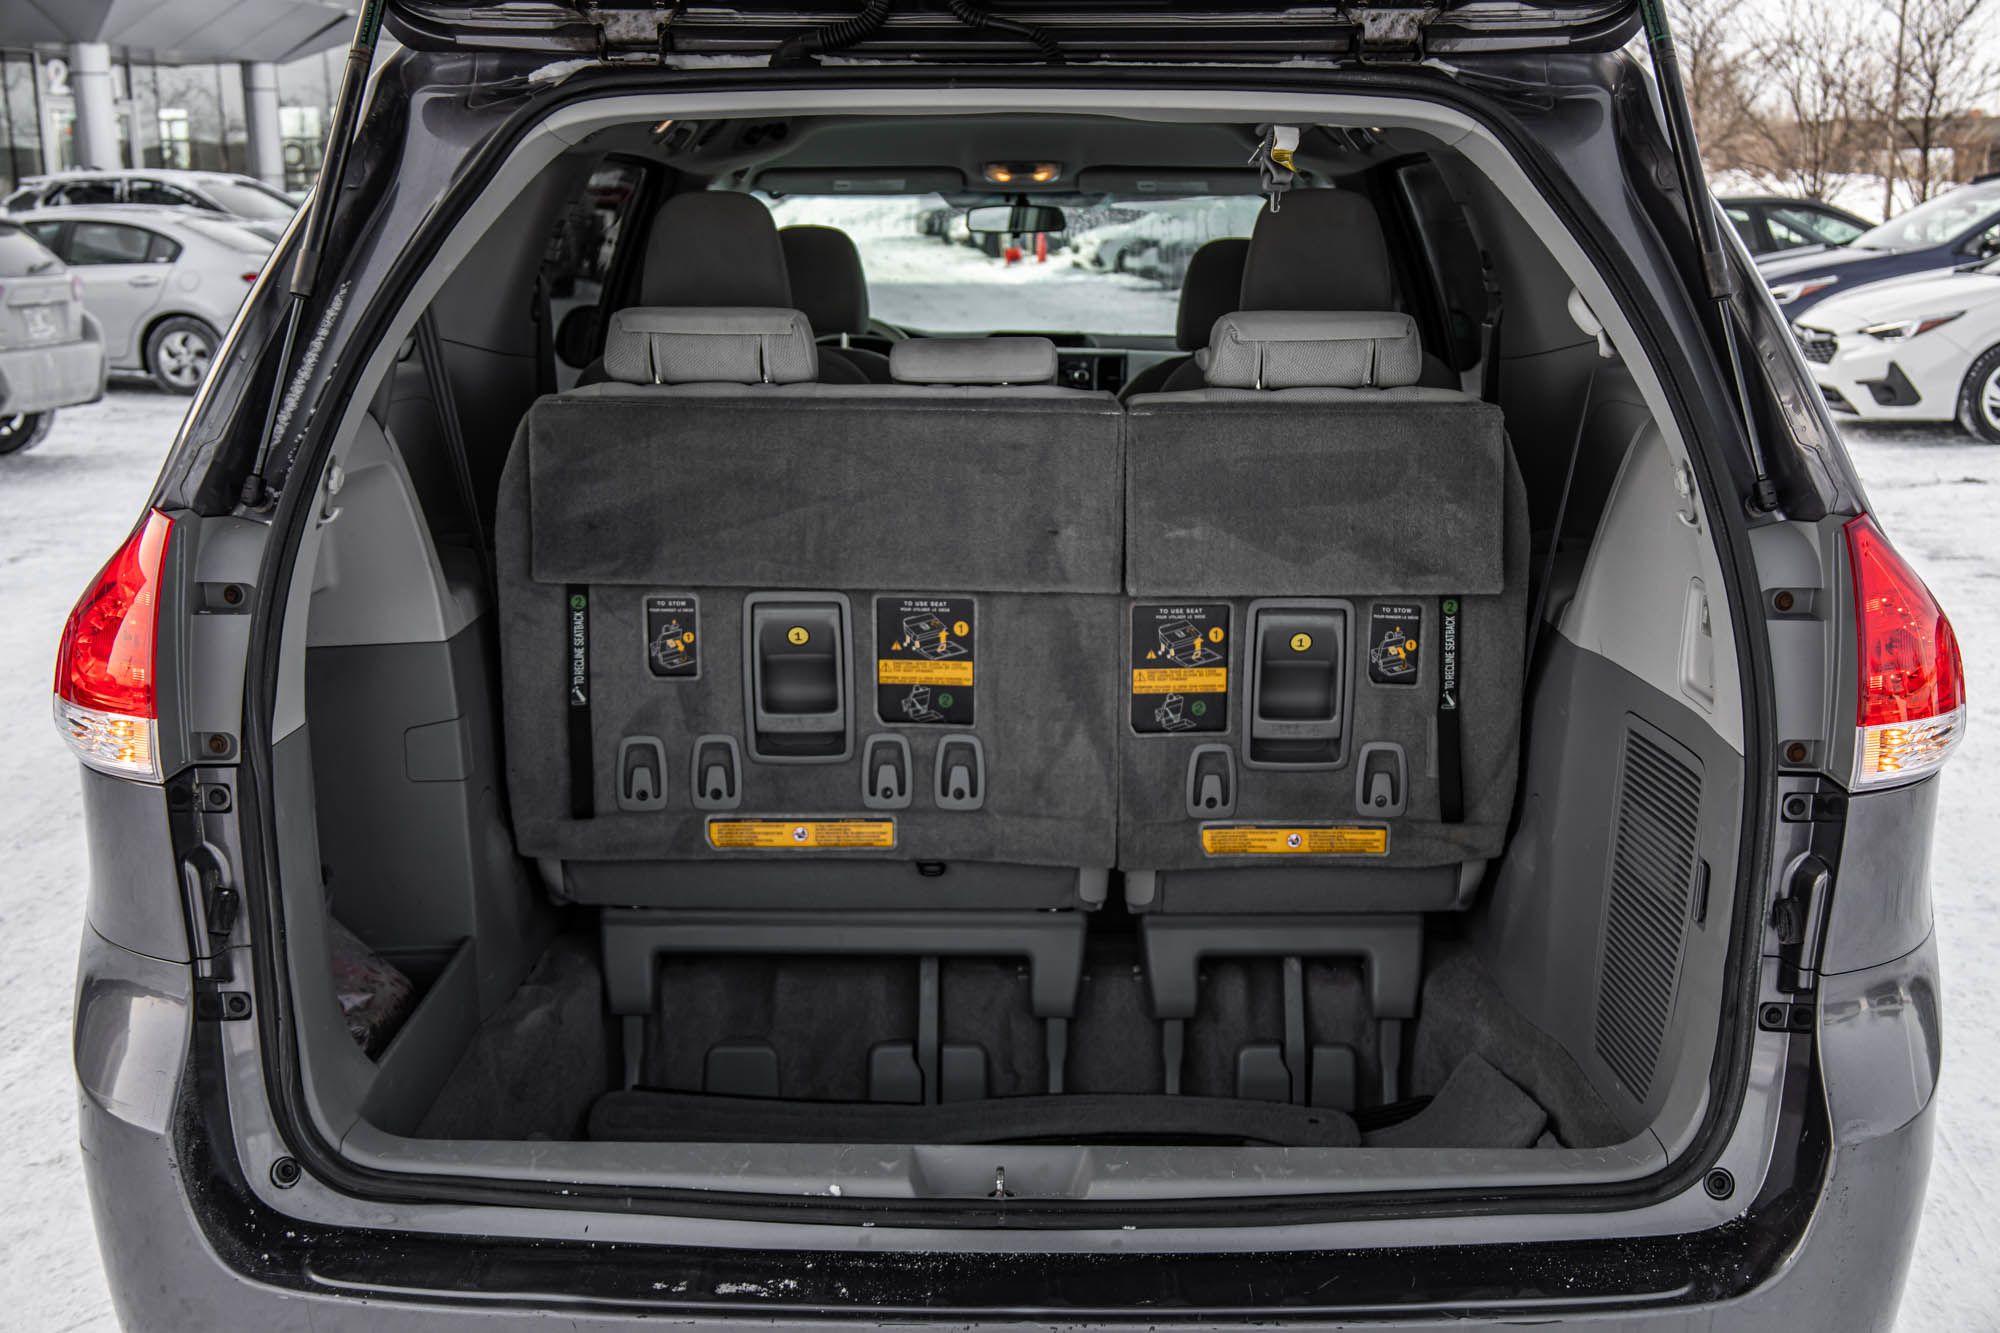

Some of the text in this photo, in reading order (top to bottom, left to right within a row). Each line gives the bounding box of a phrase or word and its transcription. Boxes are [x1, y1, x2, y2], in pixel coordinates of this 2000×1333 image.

[574, 611, 585, 685] TO RECLINE SEATBACK
[1445, 615, 1455, 690] TO RECLINE SEATBACK
